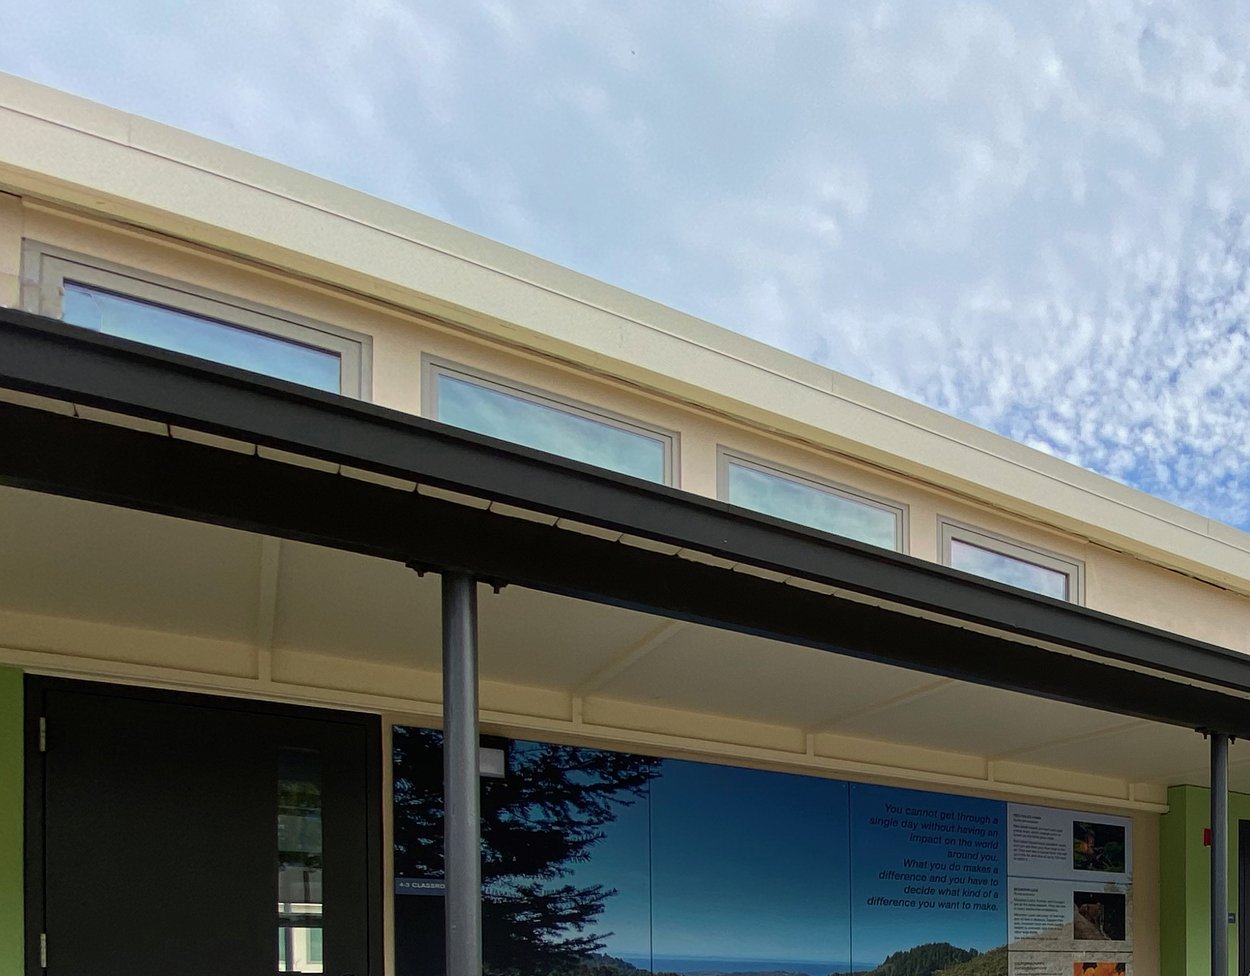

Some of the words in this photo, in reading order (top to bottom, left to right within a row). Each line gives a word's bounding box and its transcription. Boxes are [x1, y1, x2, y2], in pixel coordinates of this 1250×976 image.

[885, 803, 902, 814] You
[905, 807, 938, 818] cannot
[940, 812, 954, 820] get
[957, 812, 991, 826] through
[869, 817, 898, 829] single
[901, 819, 919, 831] day
[921, 822, 955, 833] without
[957, 825, 985, 838] having
[909, 833, 942, 845] impact
[944, 838, 956, 846] on
[958, 838, 972, 847] the
[974, 840, 999, 850] world
[947, 850, 978, 860] around
[980, 853, 998, 863] you.
[903, 858, 928, 869] What
[930, 862, 946, 872] you
[948, 861, 961, 872] do
[963, 863, 991, 874] makes
[878, 870, 927, 882] difference
[929, 874, 947, 883] and
[949, 877, 965, 886] you
[967, 876, 988, 886] have
[990, 878, 999, 887] to
[903, 885, 935, 895] decide
[938, 887, 960, 897] what
[962, 888, 980, 898] kind
[982, 889, 992, 898] of
[866, 896, 916, 907] difference
[918, 900, 935, 910] you
[938, 900, 960, 910] want
[962, 901, 971, 910] to
[972, 901, 999, 912] make.
